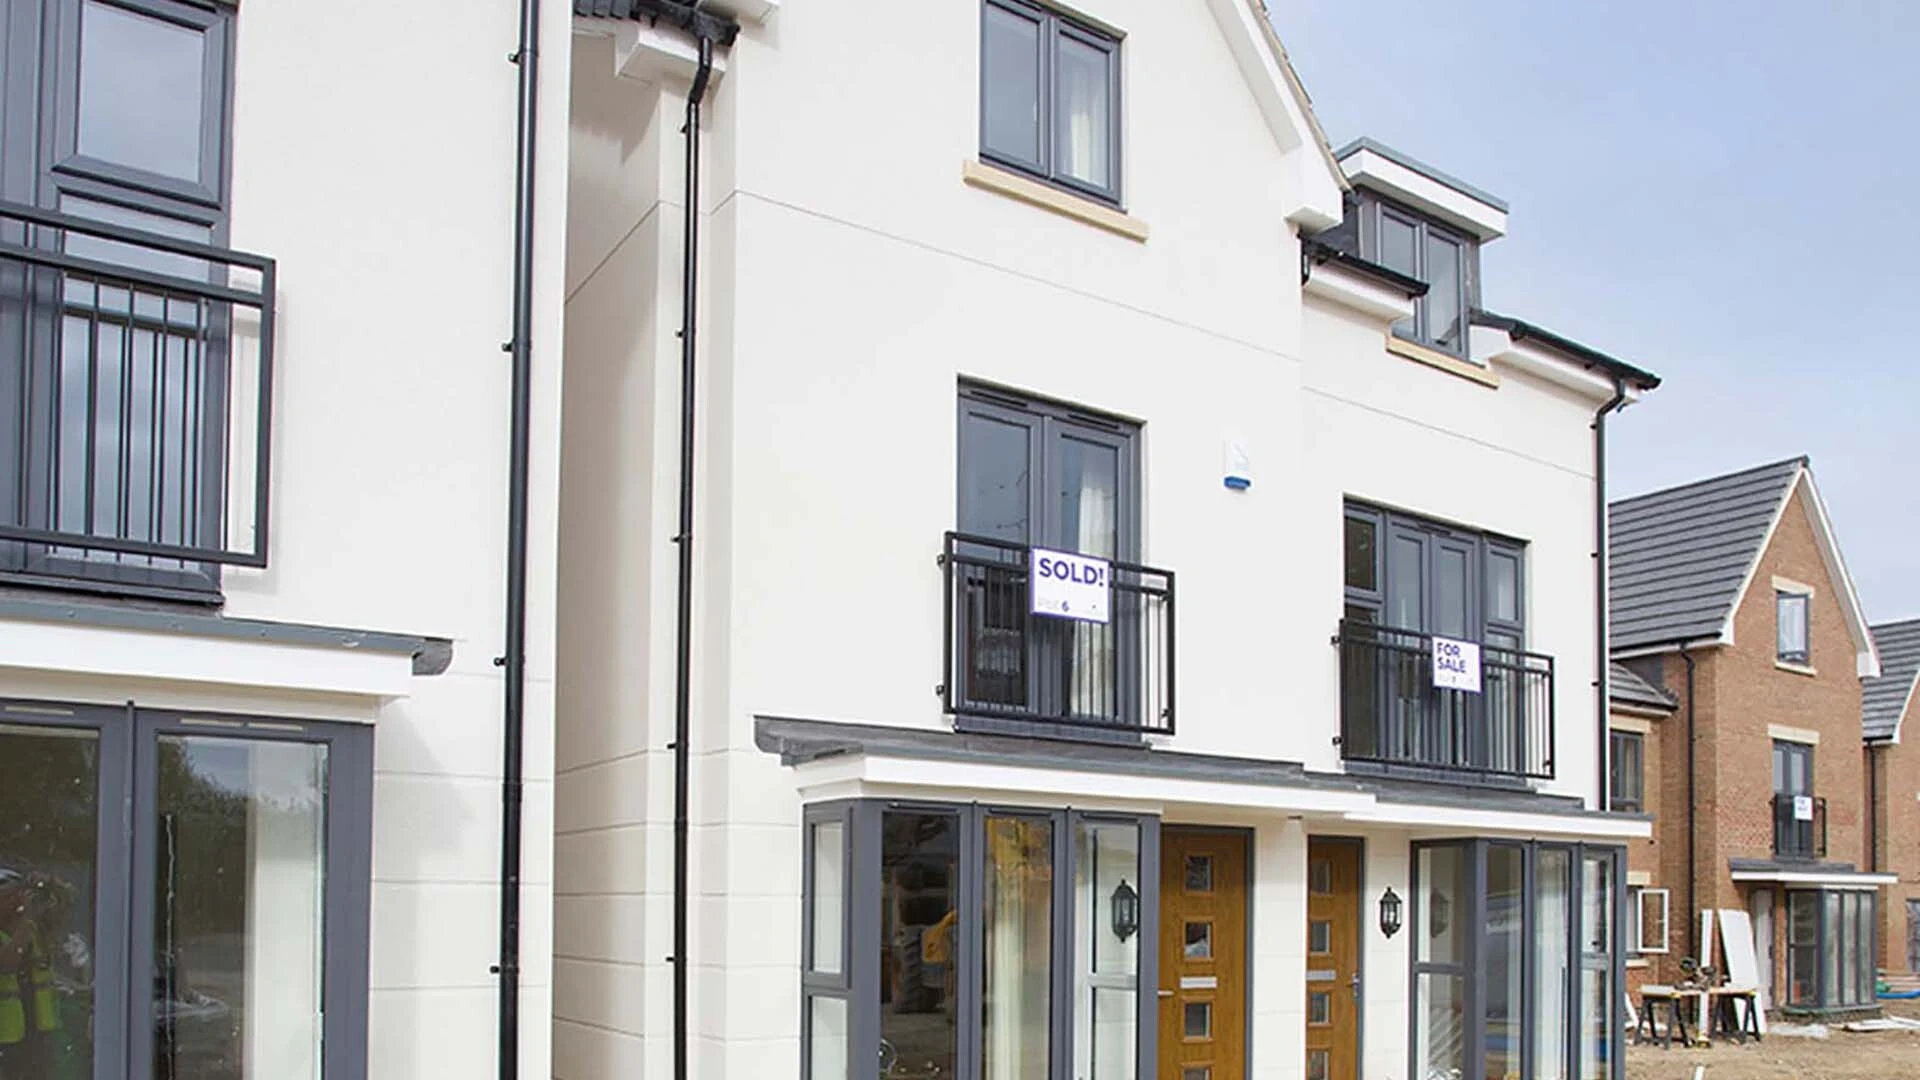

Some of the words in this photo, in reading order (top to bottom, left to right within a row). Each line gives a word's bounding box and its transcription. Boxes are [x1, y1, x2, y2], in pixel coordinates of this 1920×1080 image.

[1039, 558, 1103, 587] SOLD!
[1437, 642, 1460, 656] FOR
[1437, 657, 1466, 673] SALE
